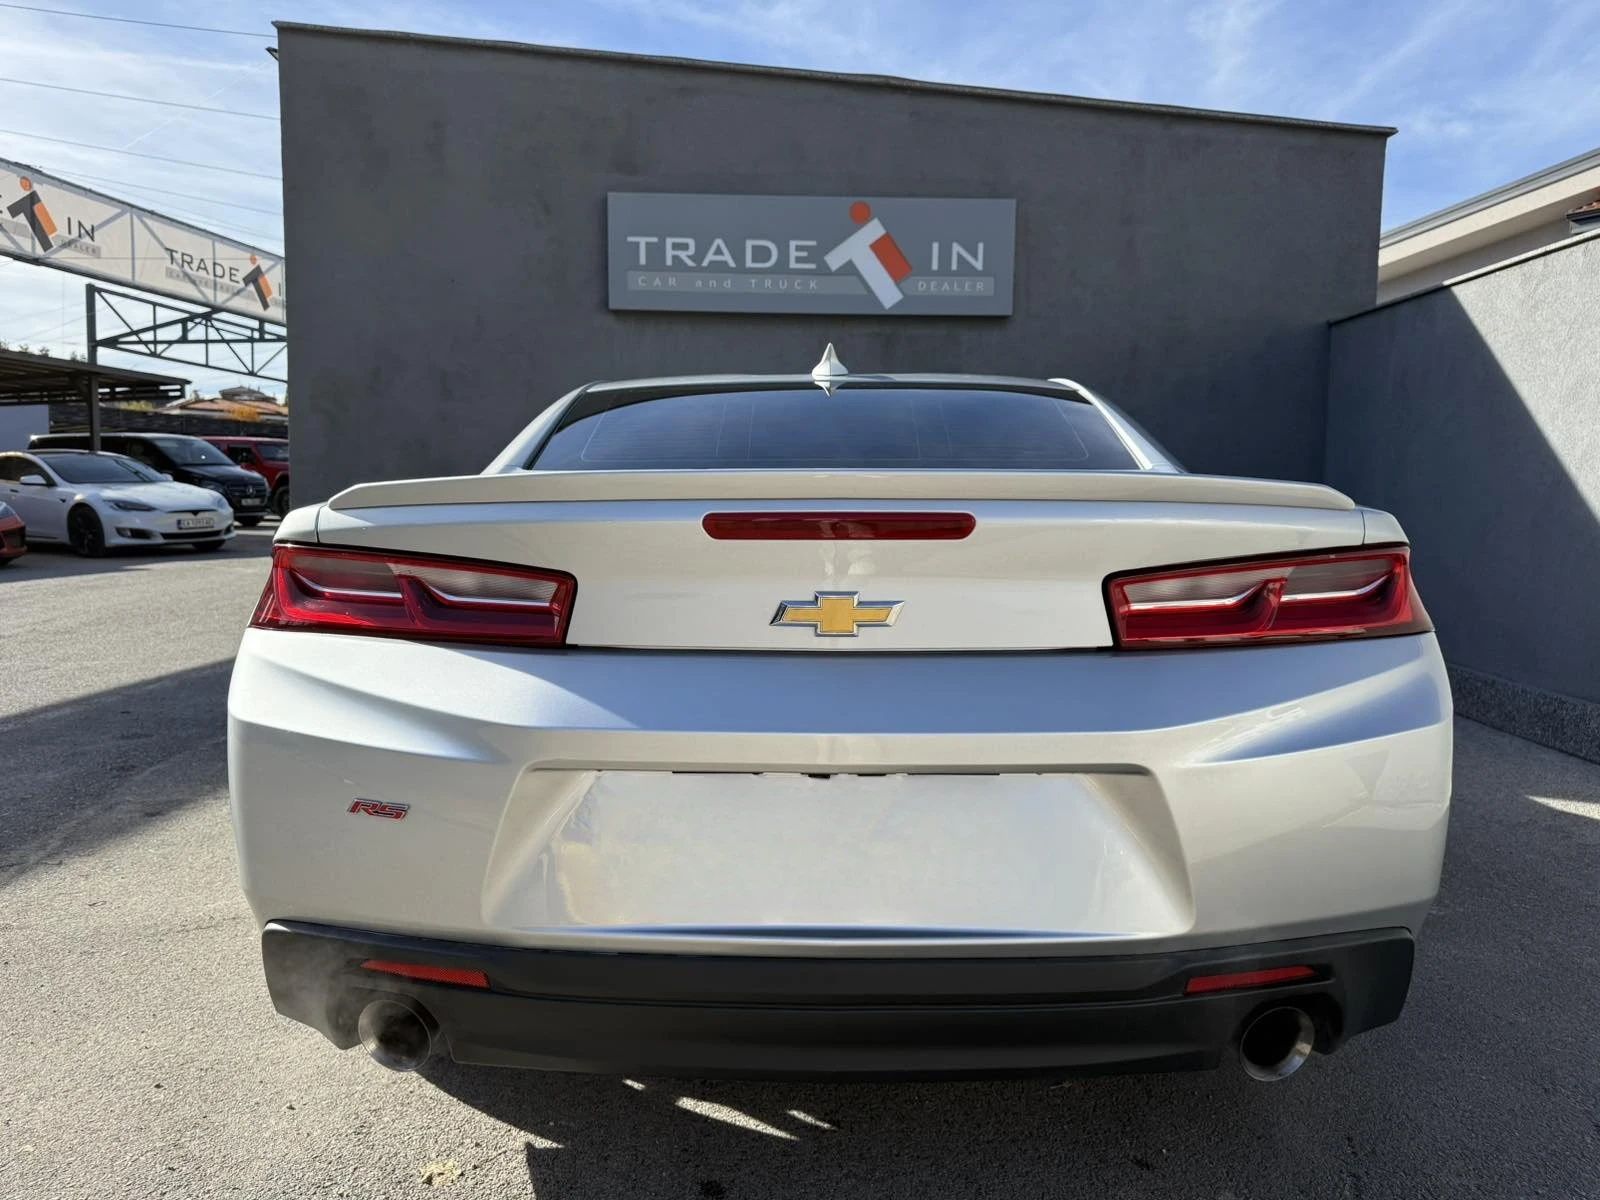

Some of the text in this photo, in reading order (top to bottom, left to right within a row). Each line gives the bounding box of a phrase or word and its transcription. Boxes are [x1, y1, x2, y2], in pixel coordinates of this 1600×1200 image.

[67, 216, 95, 242] IN
[165, 247, 240, 283] TRADE
[627, 236, 984, 271] TRADE IN
[638, 275, 985, 292] CAR and TRUCK DEALER
[347, 798, 411, 820] RS
